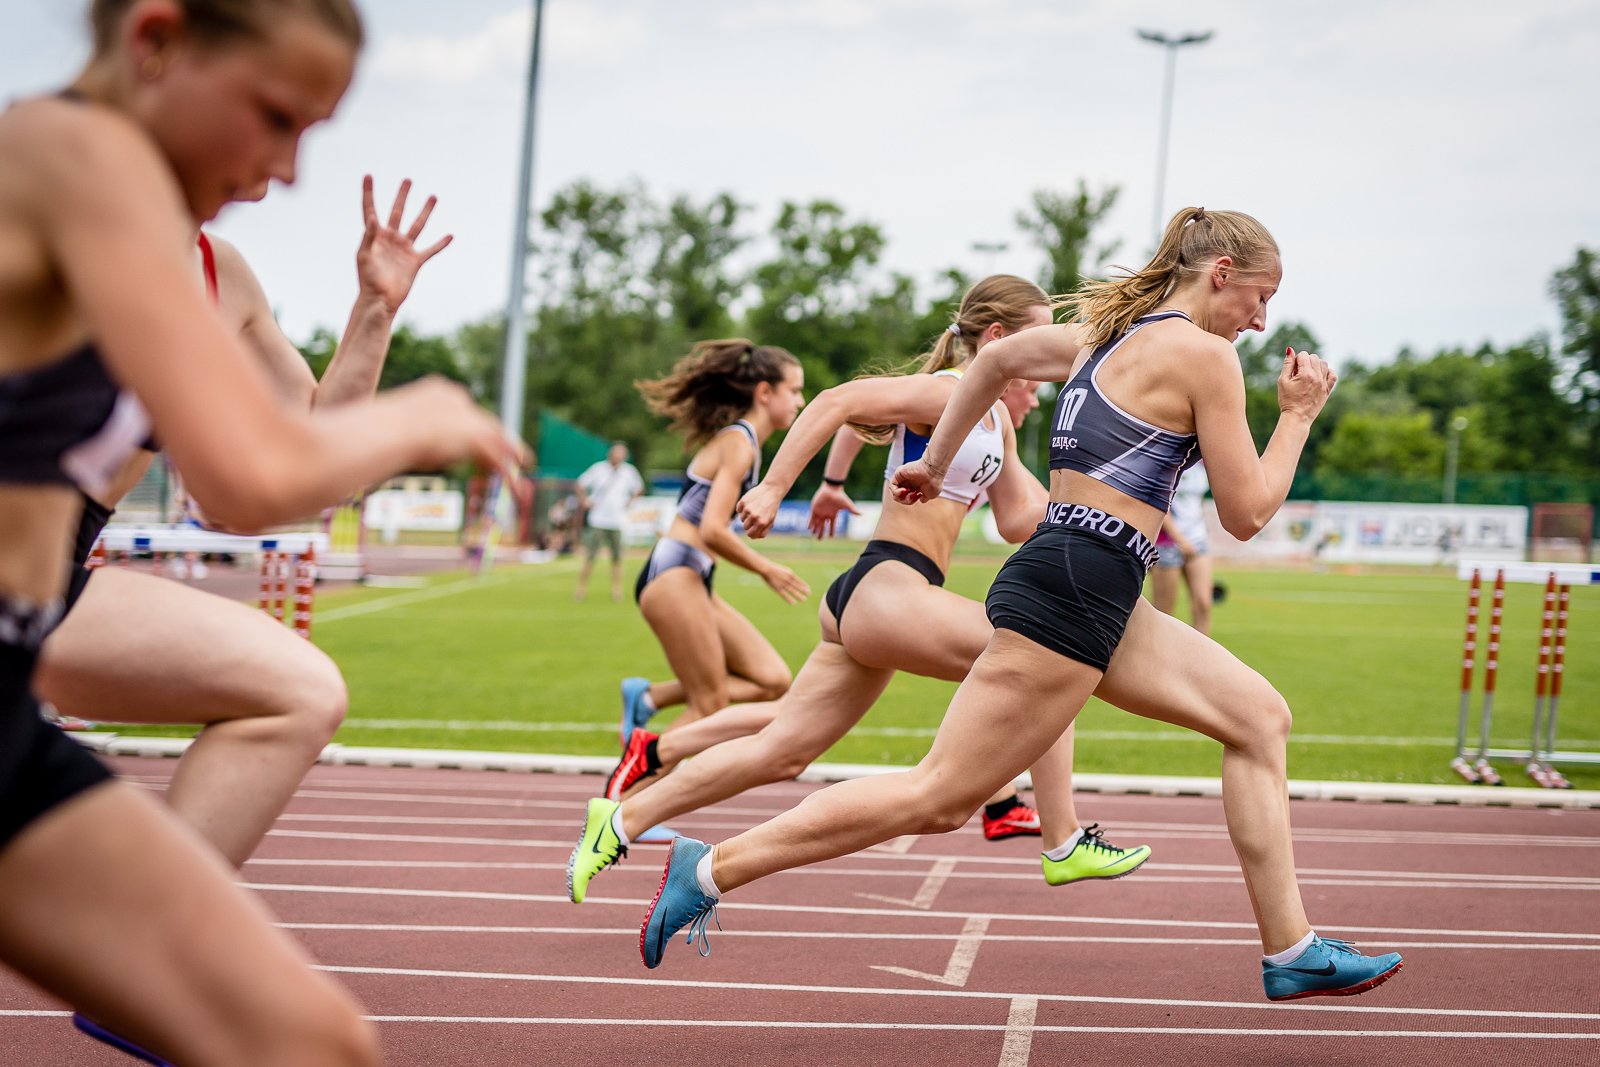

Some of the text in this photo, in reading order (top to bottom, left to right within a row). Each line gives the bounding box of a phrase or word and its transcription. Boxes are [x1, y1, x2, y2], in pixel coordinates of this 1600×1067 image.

[1057, 388, 1088, 431] 117
[970, 454, 1001, 486] 87
[1065, 504, 1125, 537] PRO
